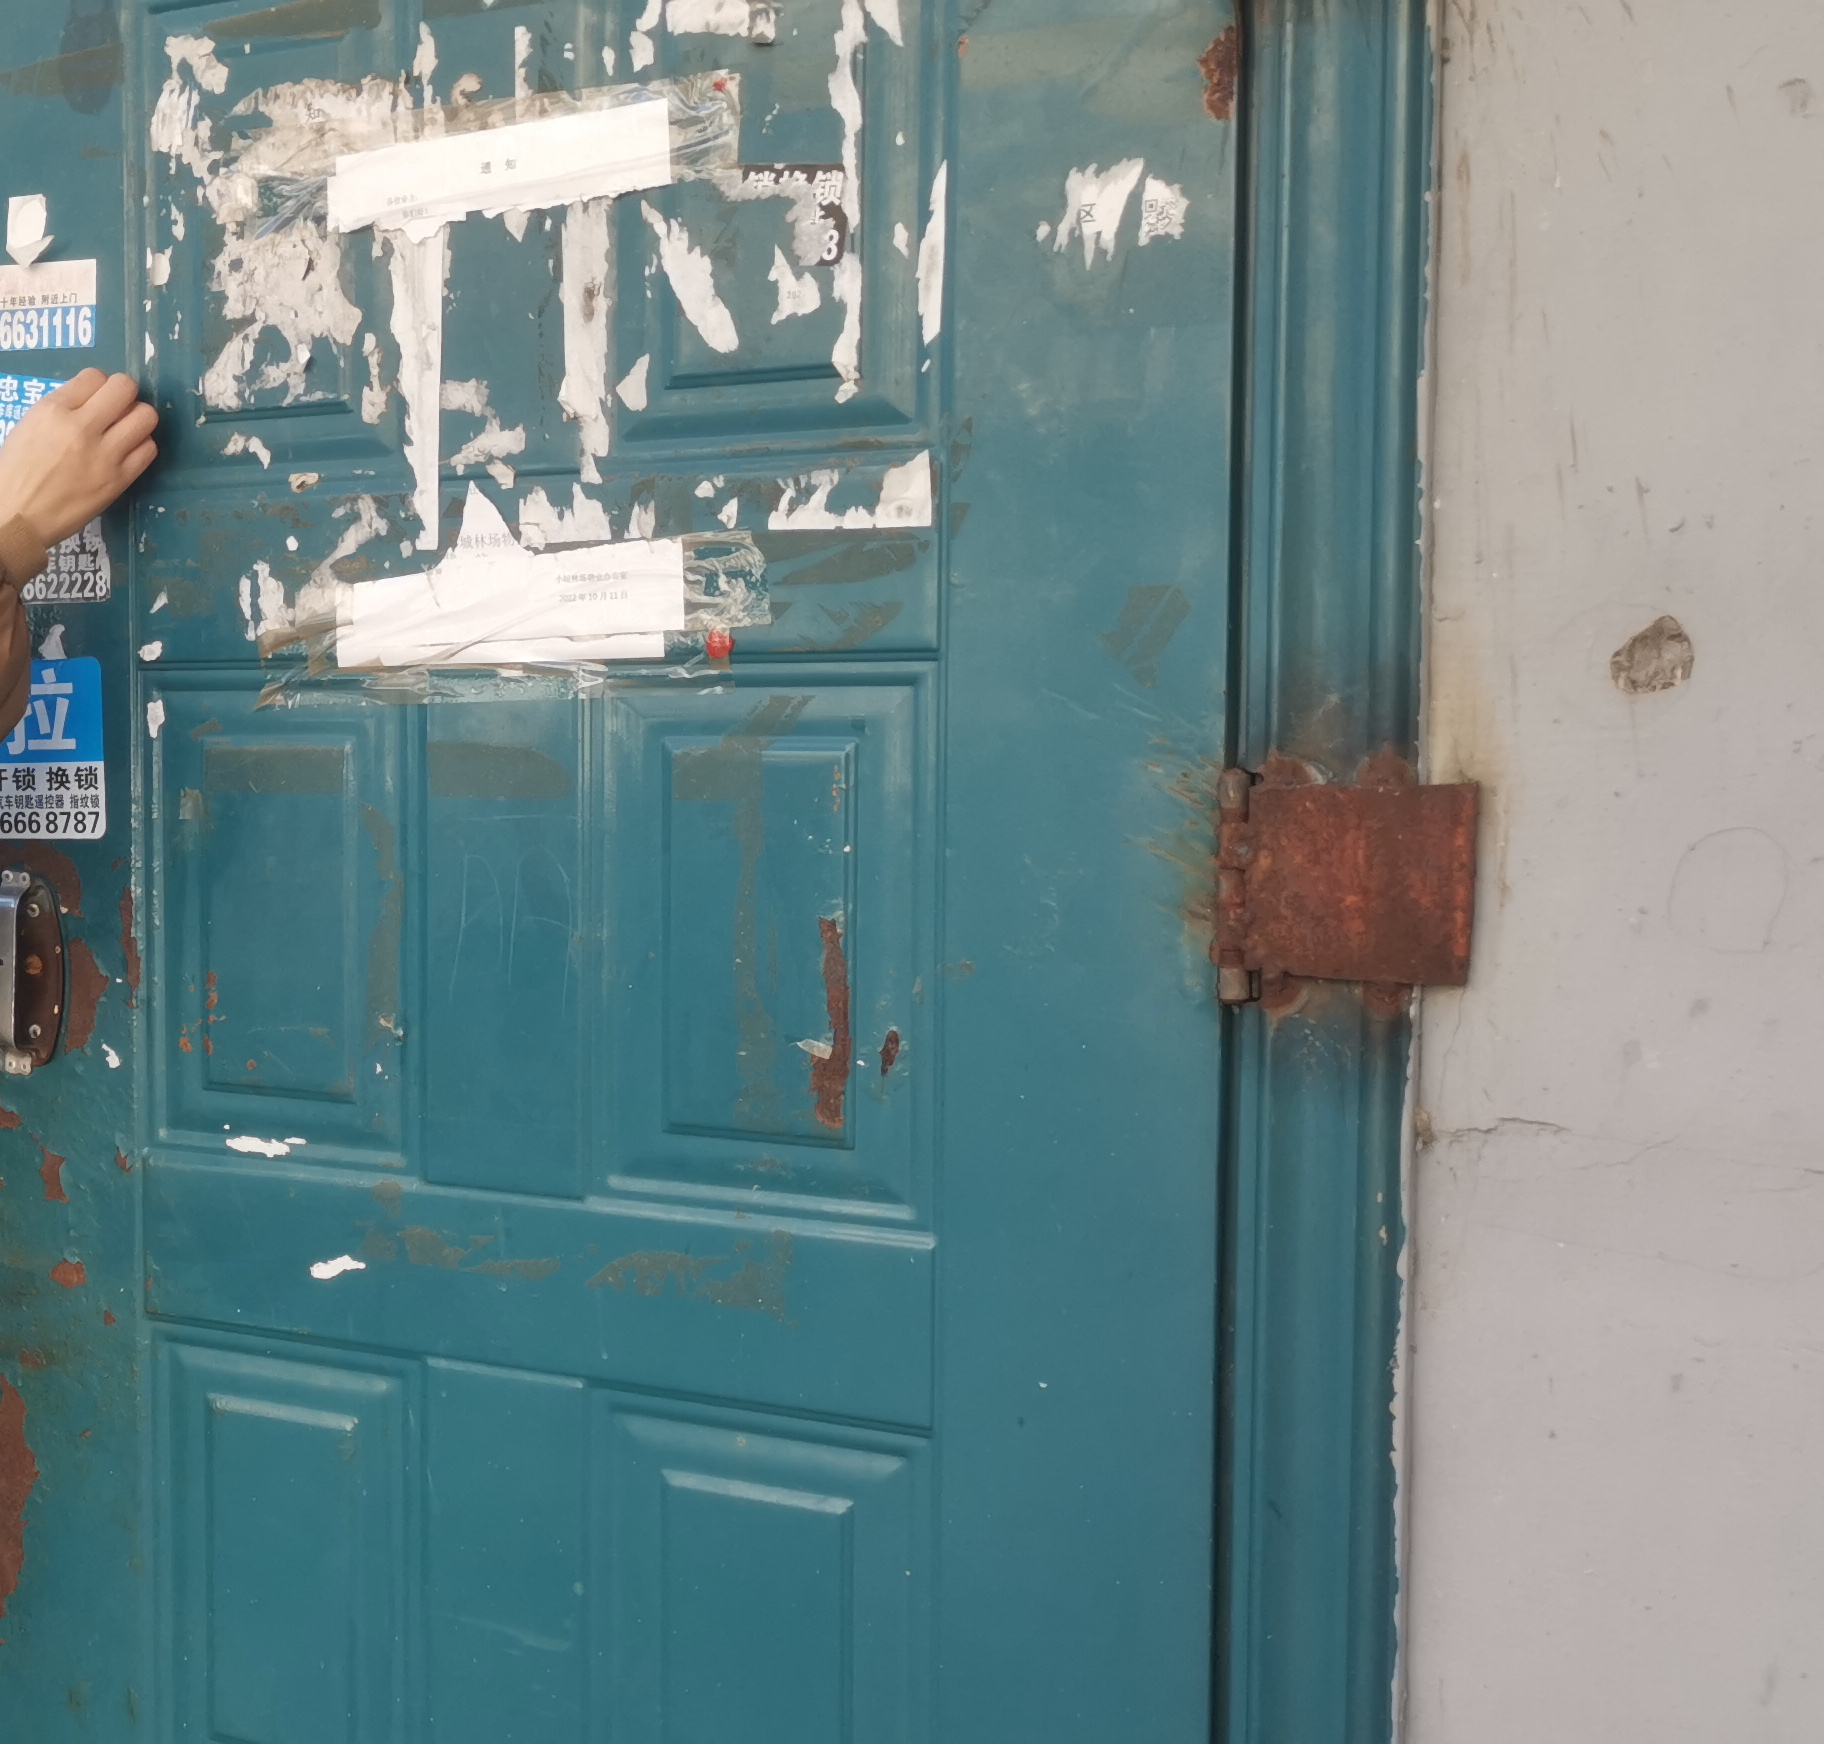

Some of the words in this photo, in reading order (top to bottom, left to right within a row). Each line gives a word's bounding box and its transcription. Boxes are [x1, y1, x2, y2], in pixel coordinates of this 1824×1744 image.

[480, 158, 517, 174] 通知
[0, 295, 36, 308] 十年经验
[41, 292, 78, 305] 附近上门
[46, 765, 99, 791] 换锁
[69, 793, 100, 809] 指纹锁
[45, 811, 100, 834] 8787
